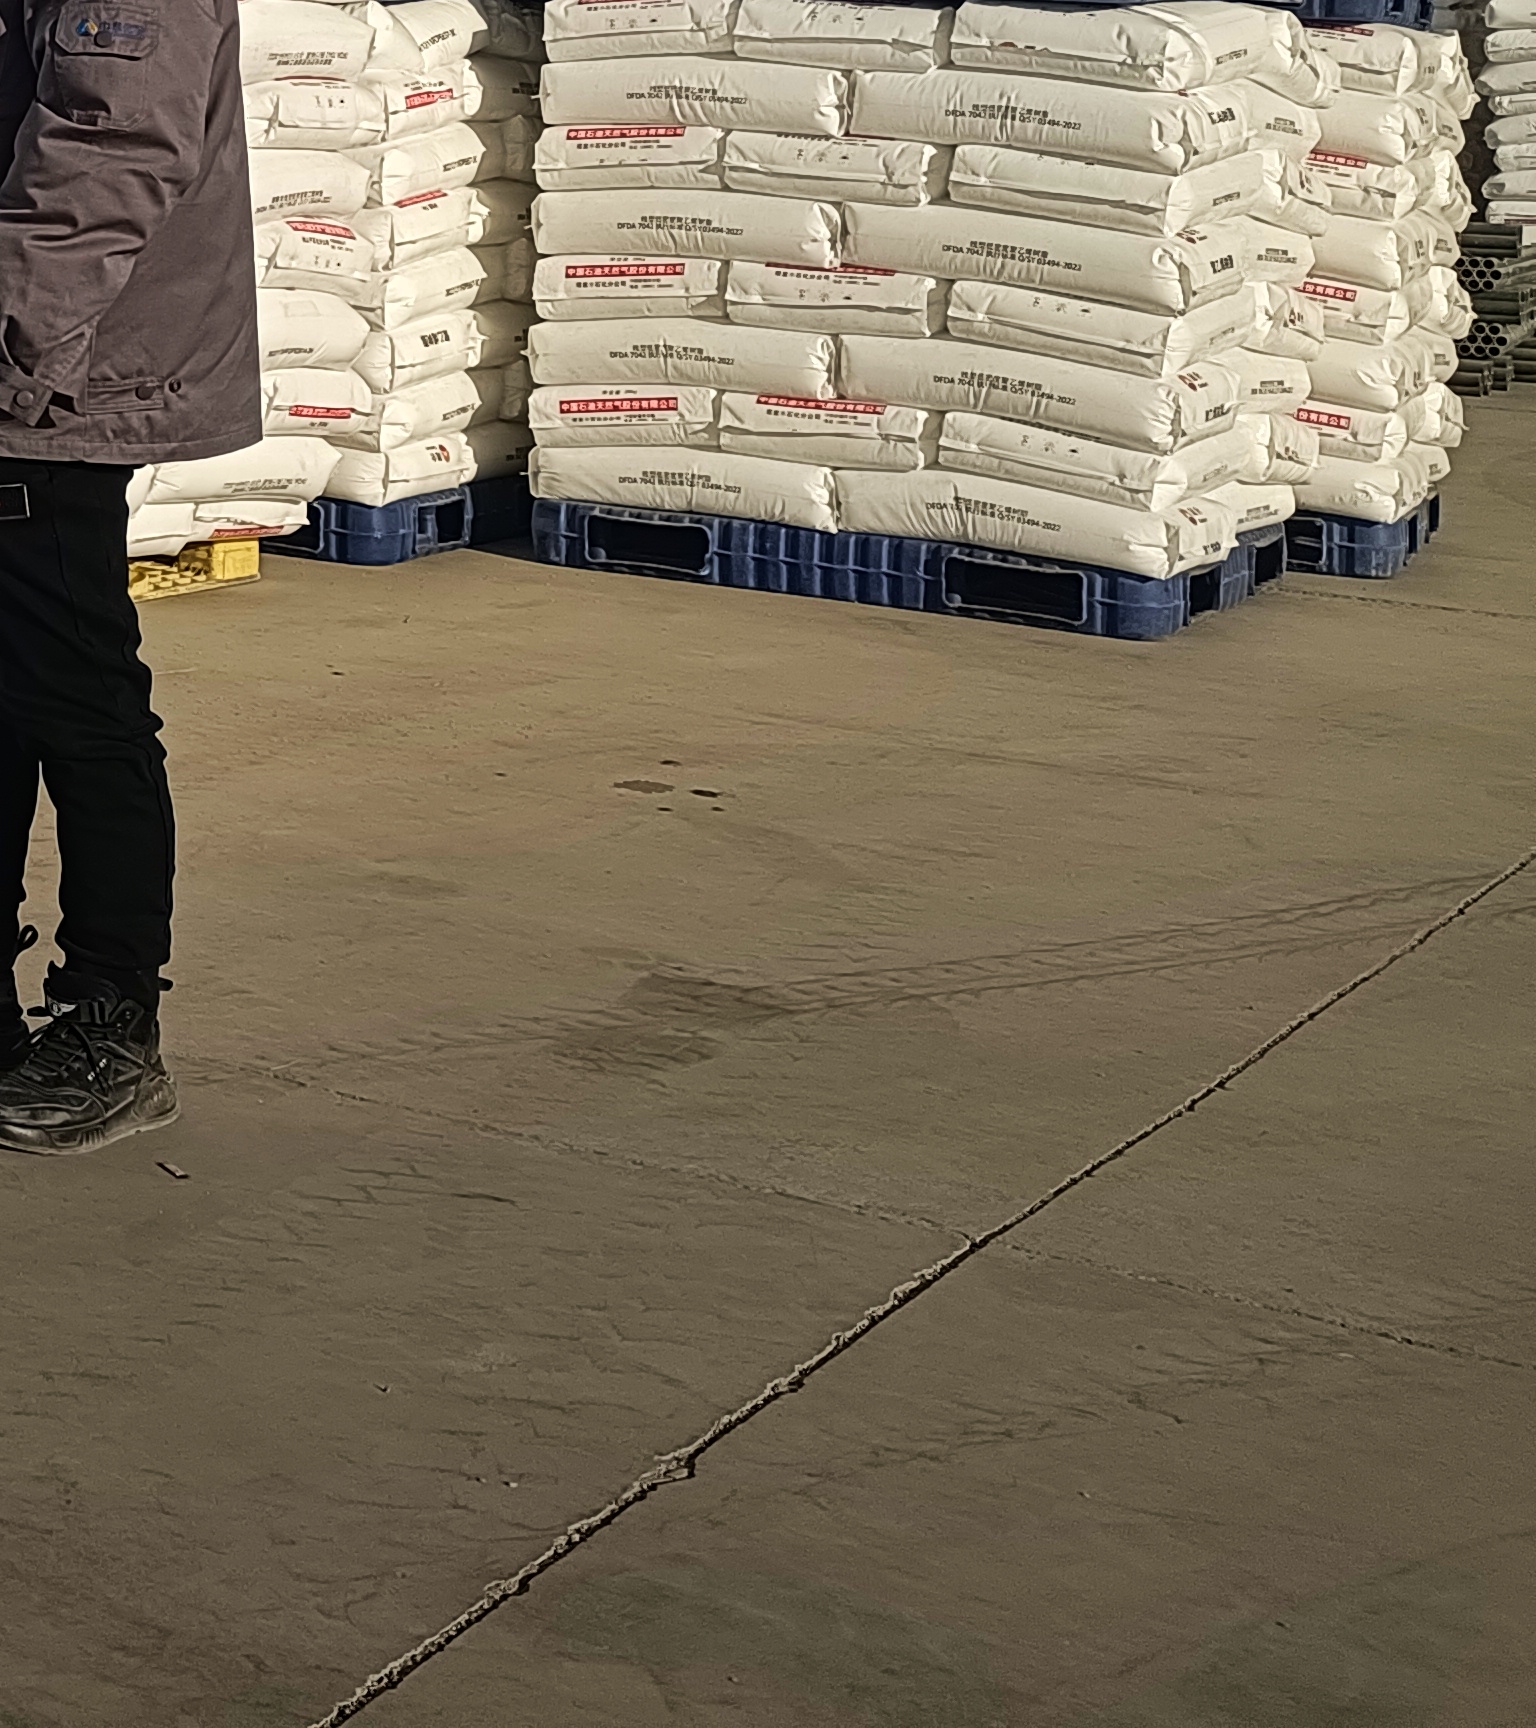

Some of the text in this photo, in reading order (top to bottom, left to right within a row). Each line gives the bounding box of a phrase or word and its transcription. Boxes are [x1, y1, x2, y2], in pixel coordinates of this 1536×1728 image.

[944, 109, 965, 117] DFDA
[1038, 119, 1081, 130] 03494-2022
[568, 127, 684, 138] 中国石油天然气股份有限公司
[567, 265, 683, 276] 中国石油天然气股份有限公司
[1037, 258, 1082, 271] 03494-2022
[933, 376, 955, 384] DFDA
[1031, 389, 1076, 405] 03494-2022
[561, 399, 677, 411] 中国石油天然气股份有限公司
[758, 396, 885, 414] 中国石油天然气股份有限公司
[1017, 515, 1061, 531] 03494-2022
